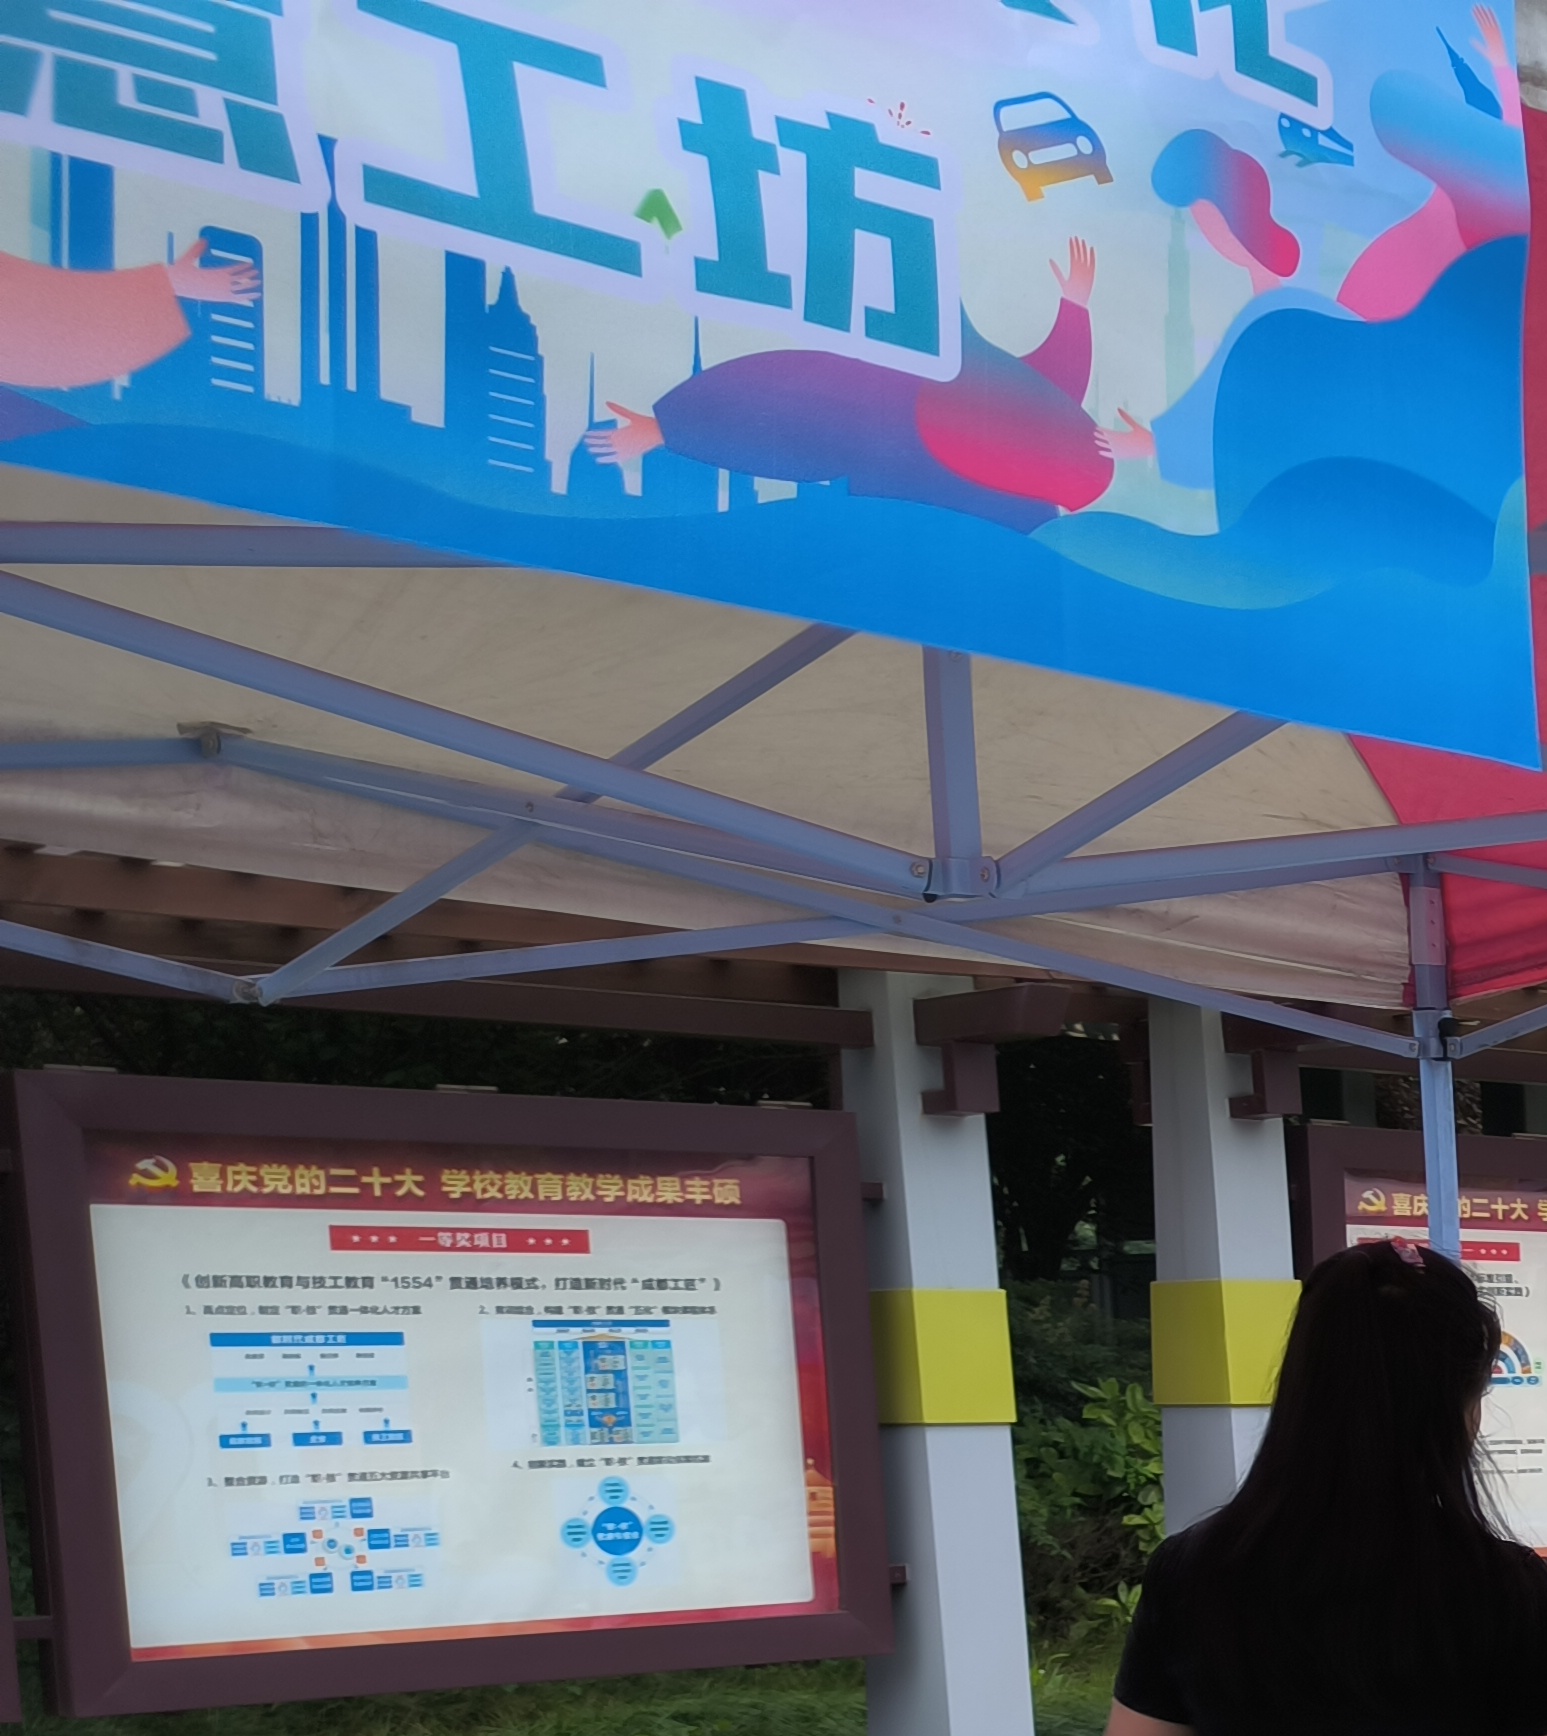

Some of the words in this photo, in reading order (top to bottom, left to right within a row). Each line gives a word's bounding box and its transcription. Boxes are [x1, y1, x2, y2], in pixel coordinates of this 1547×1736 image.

[189, 1161, 426, 1200] 喜庆党的二十大
[440, 1168, 742, 1207] 学校教育教学成果丰硕
[1391, 1191, 1530, 1222] 喜庆的二十大
